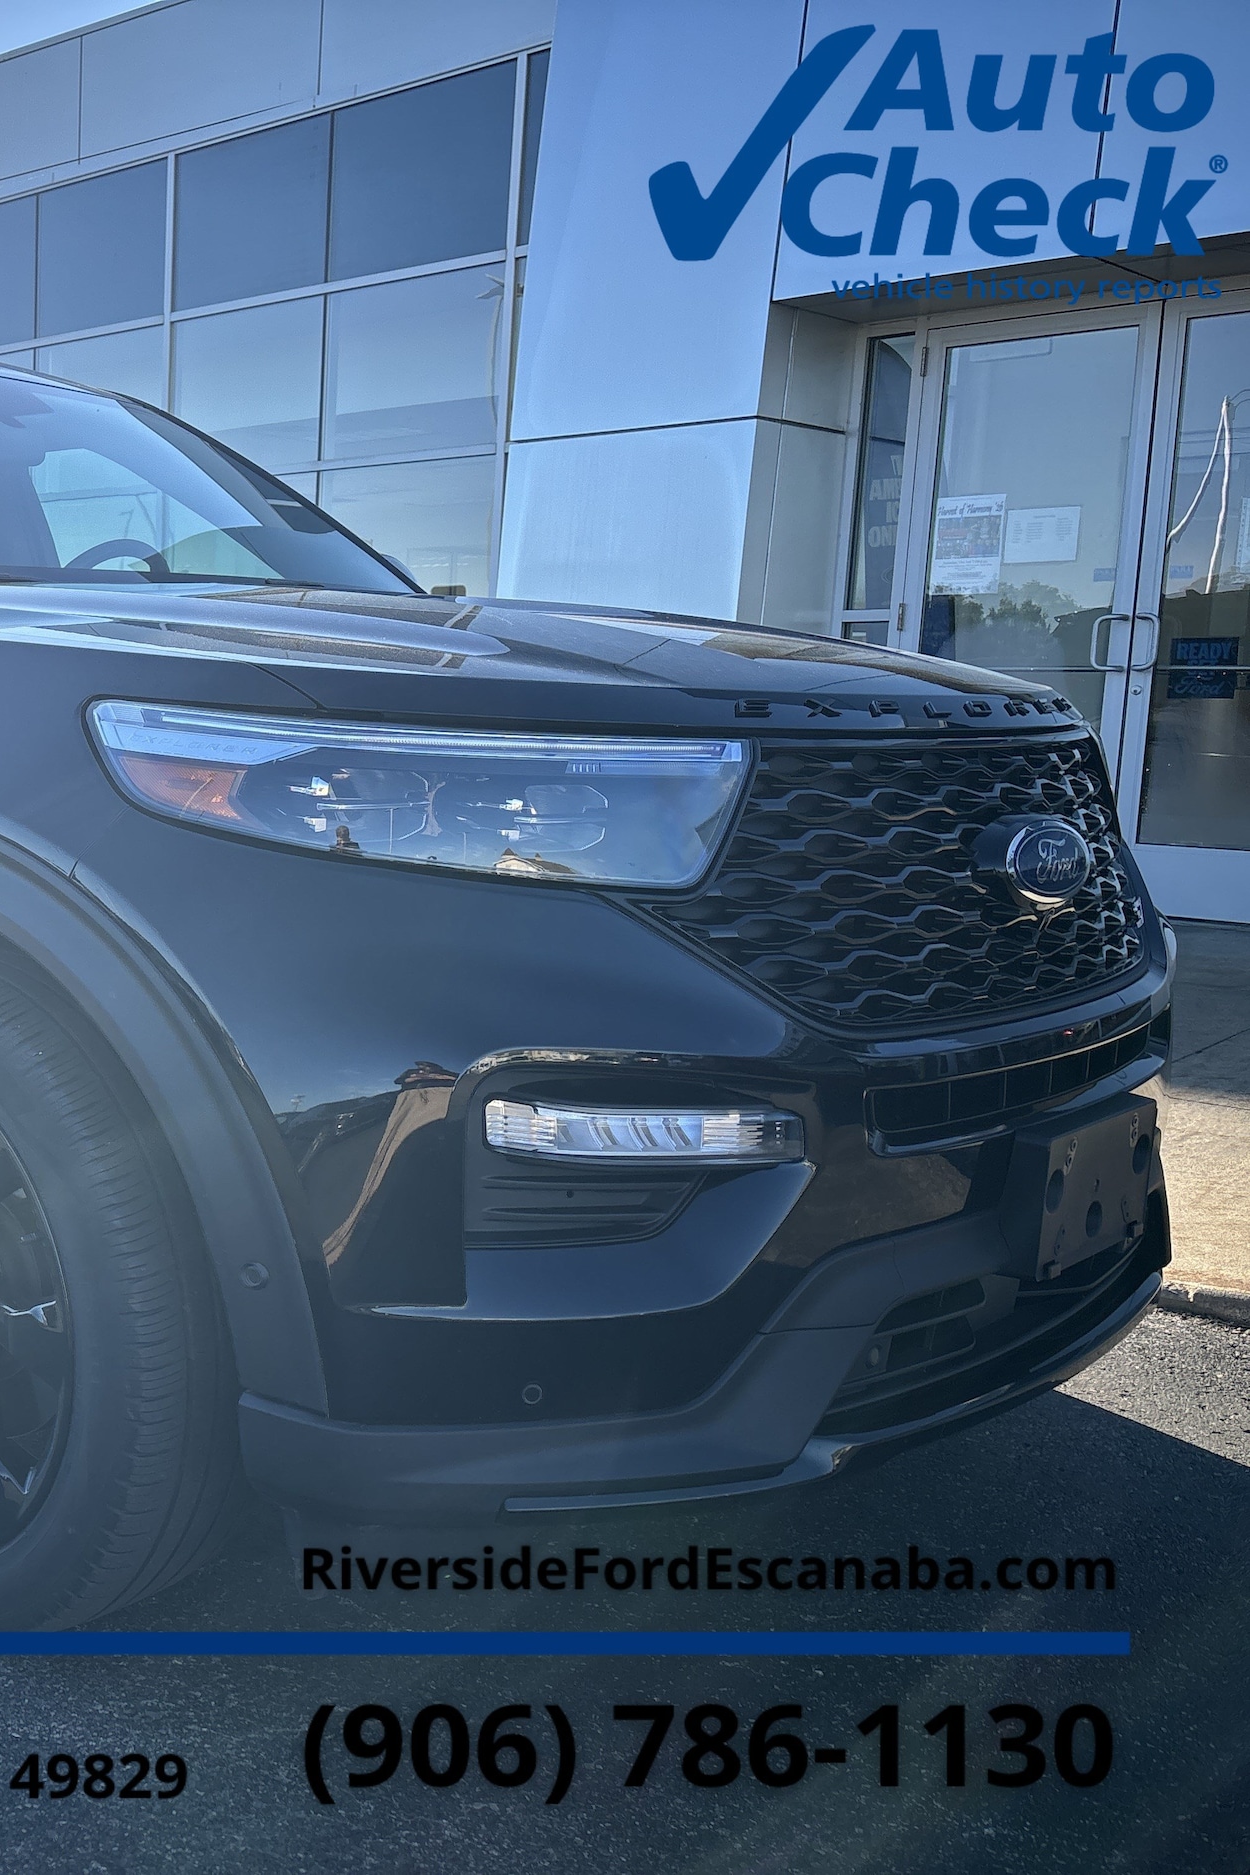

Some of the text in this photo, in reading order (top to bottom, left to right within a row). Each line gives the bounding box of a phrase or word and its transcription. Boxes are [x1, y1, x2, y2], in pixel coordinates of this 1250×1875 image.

[1176, 642, 1232, 660] READY
[734, 696, 1073, 719] EXPLORER
[1036, 838, 1080, 884] Ford
